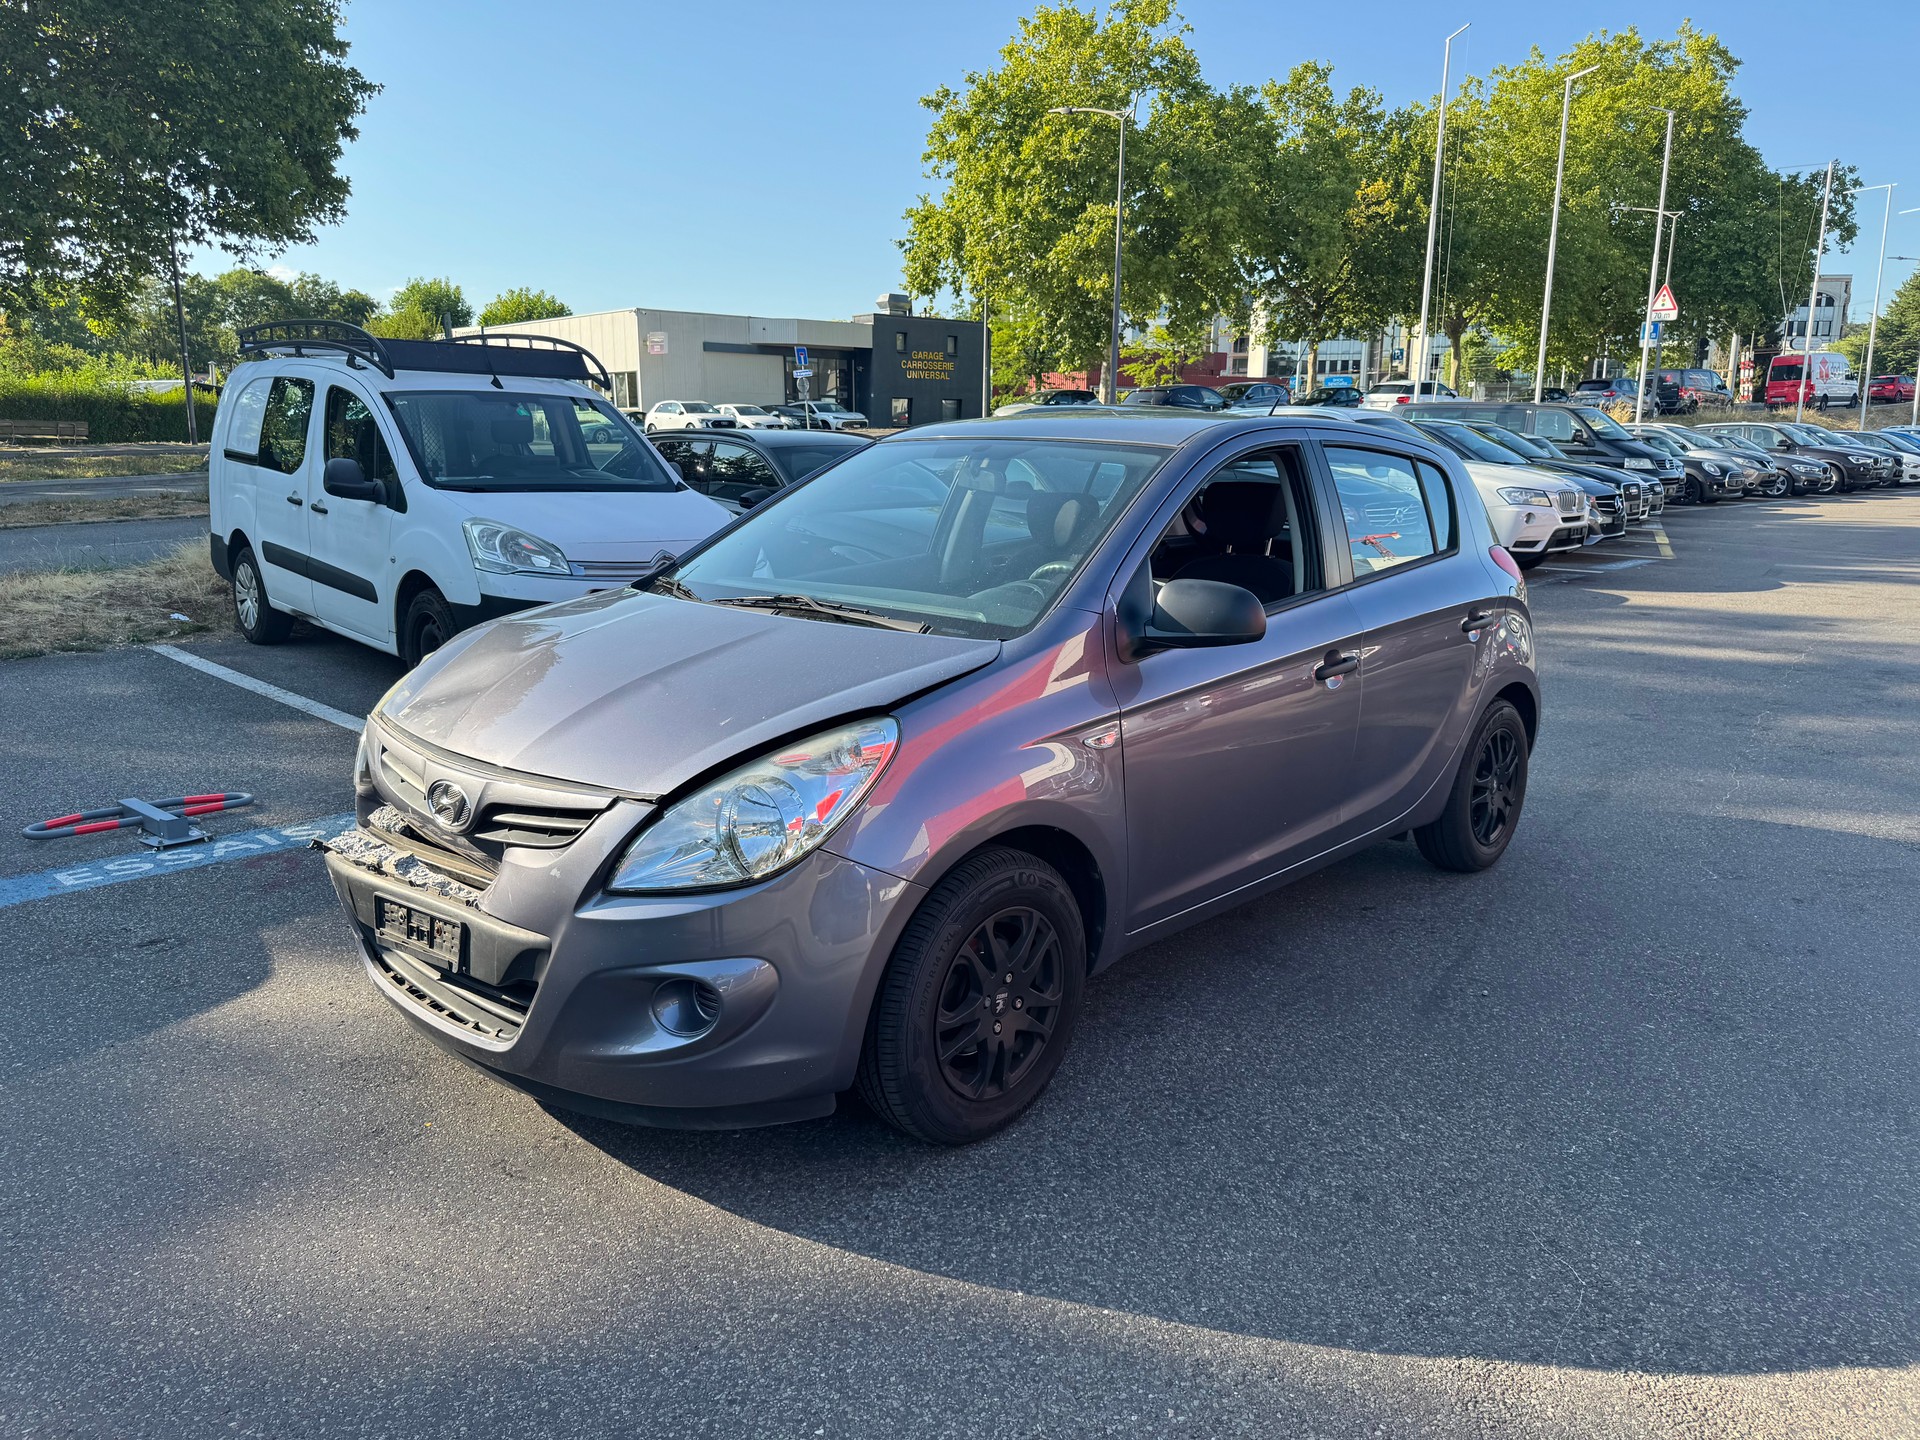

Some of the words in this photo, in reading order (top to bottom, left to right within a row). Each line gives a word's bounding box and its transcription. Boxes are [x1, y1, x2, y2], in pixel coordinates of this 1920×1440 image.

[911, 351, 944, 360] GARAGE
[901, 360, 954, 370] CARROSSERIE
[906, 370, 950, 380] UNIVERSAL
[53, 826, 327, 886] ESSAIS
